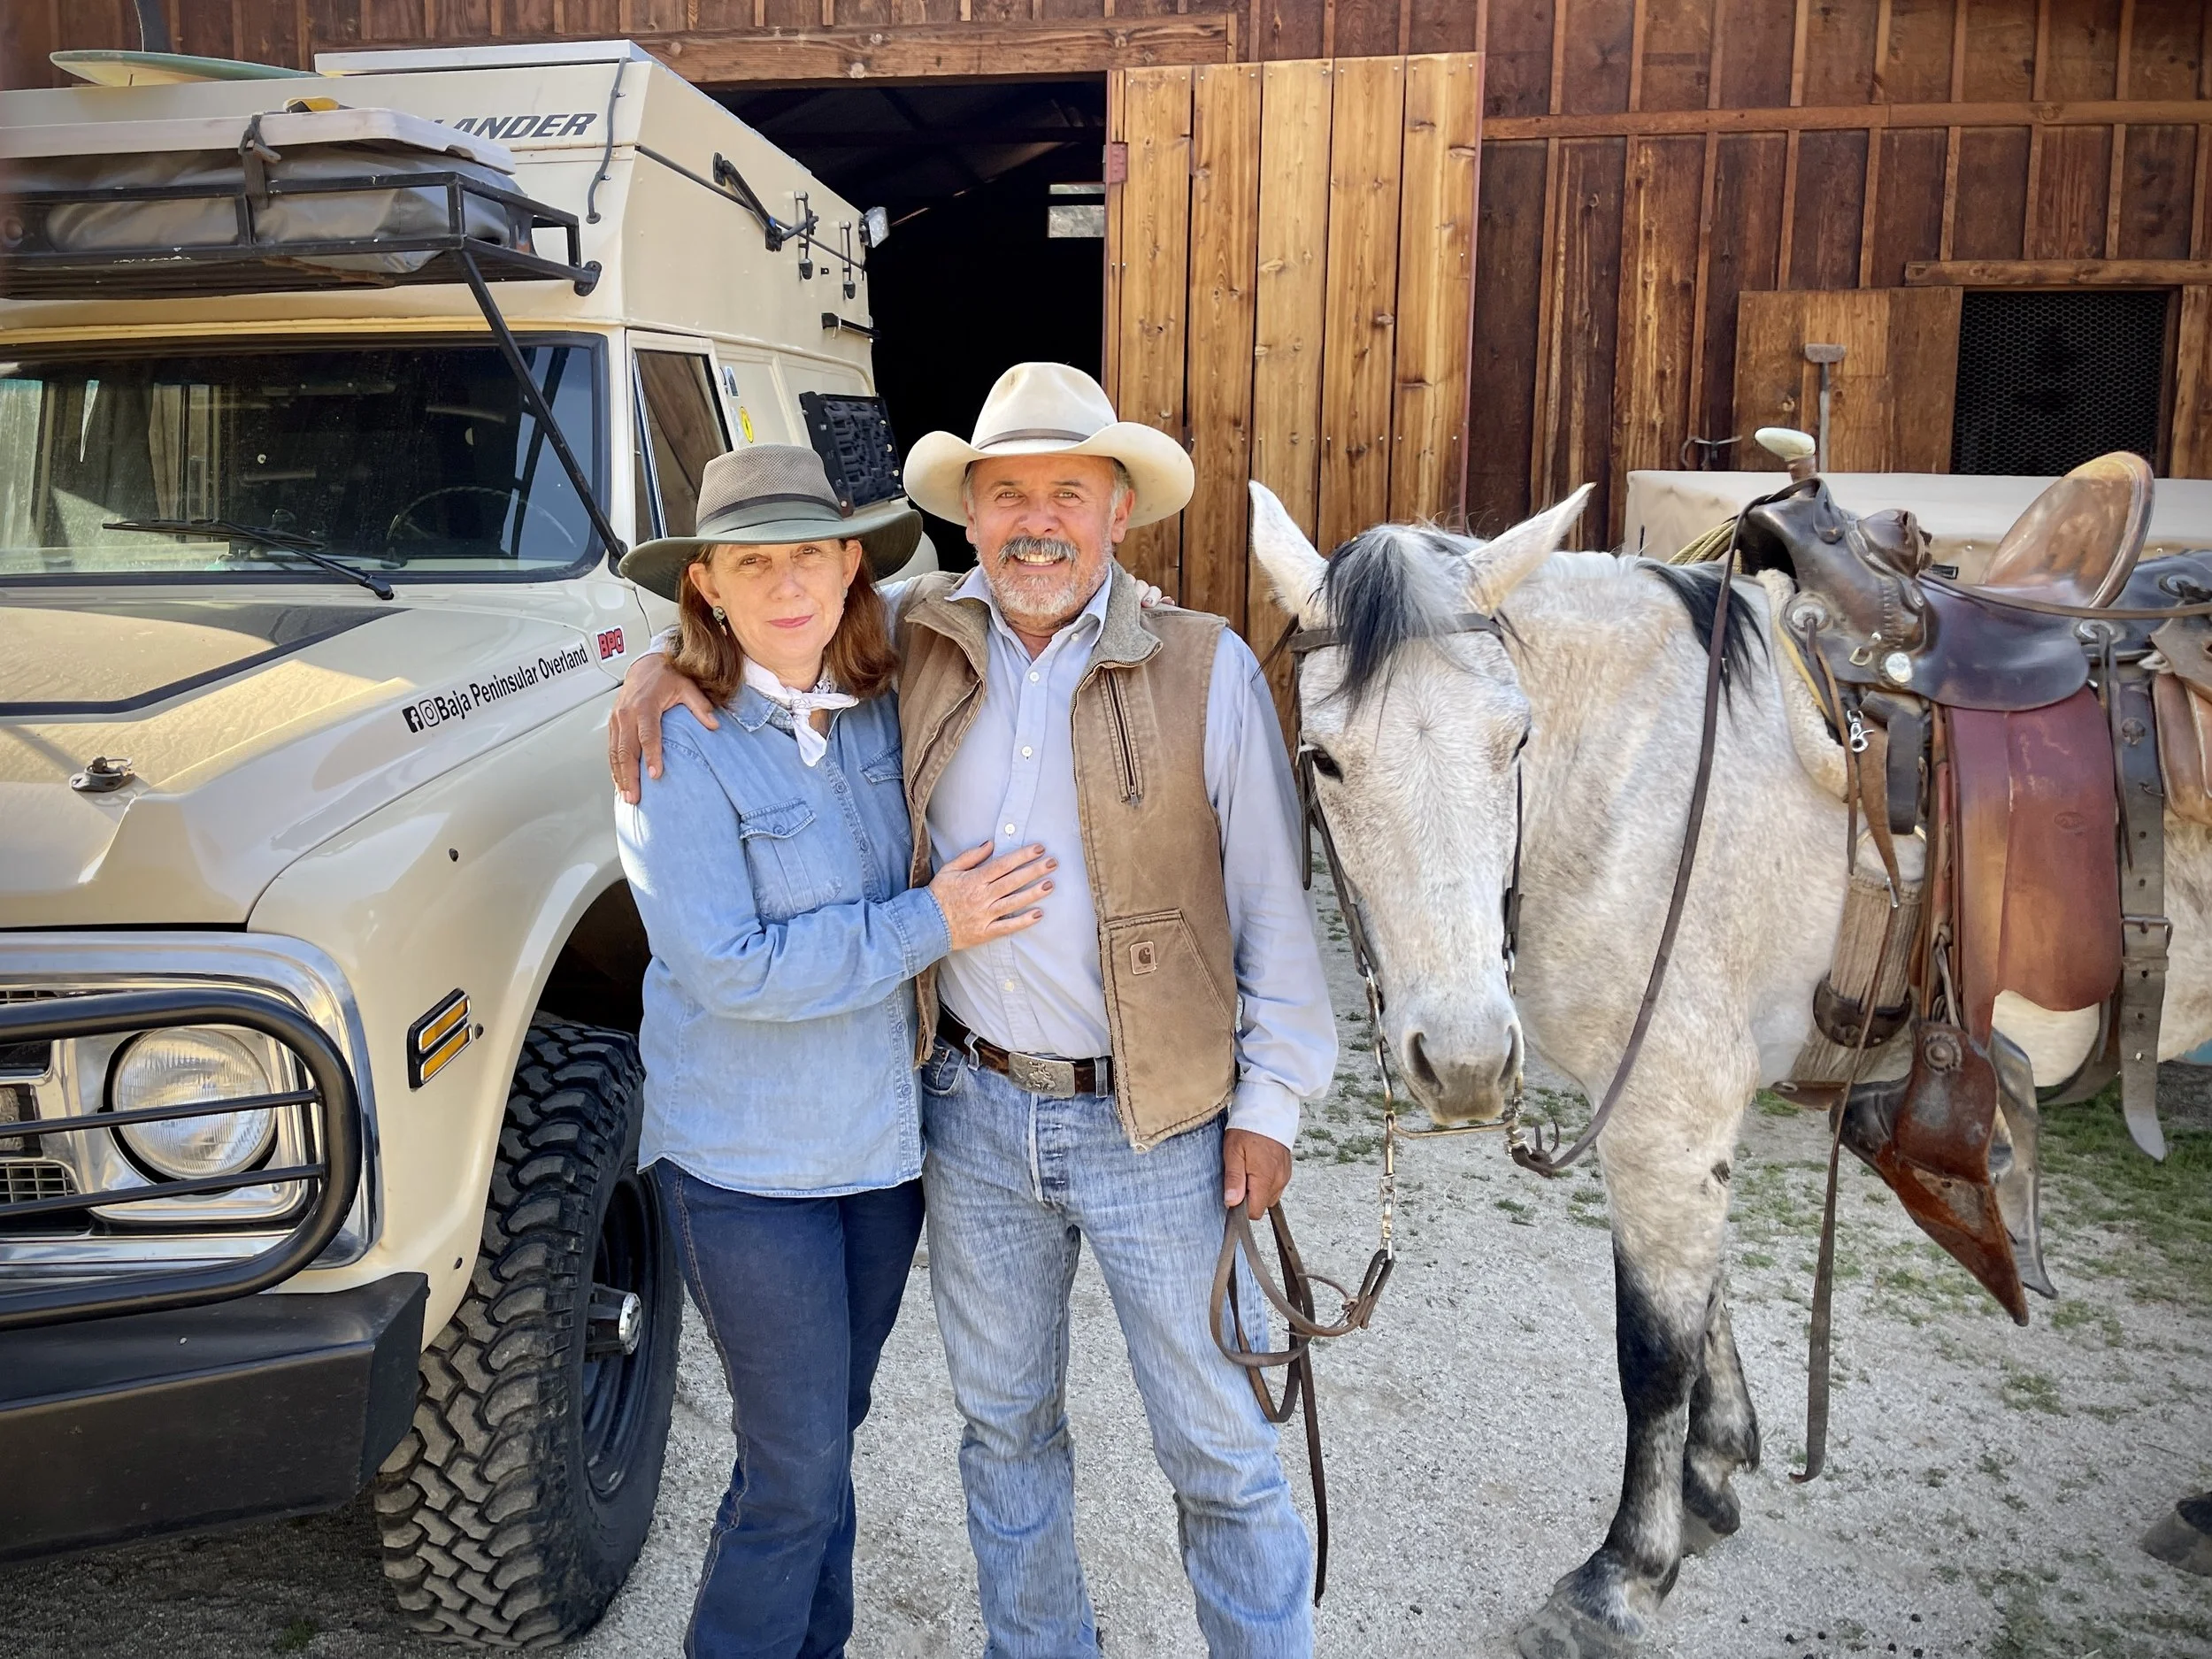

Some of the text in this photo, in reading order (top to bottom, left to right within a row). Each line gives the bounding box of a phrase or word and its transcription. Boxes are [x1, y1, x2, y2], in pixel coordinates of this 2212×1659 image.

[434, 113, 597, 139] ANDER
[597, 628, 625, 660] BPO
[434, 642, 588, 719] Baja Peninsular Overland
